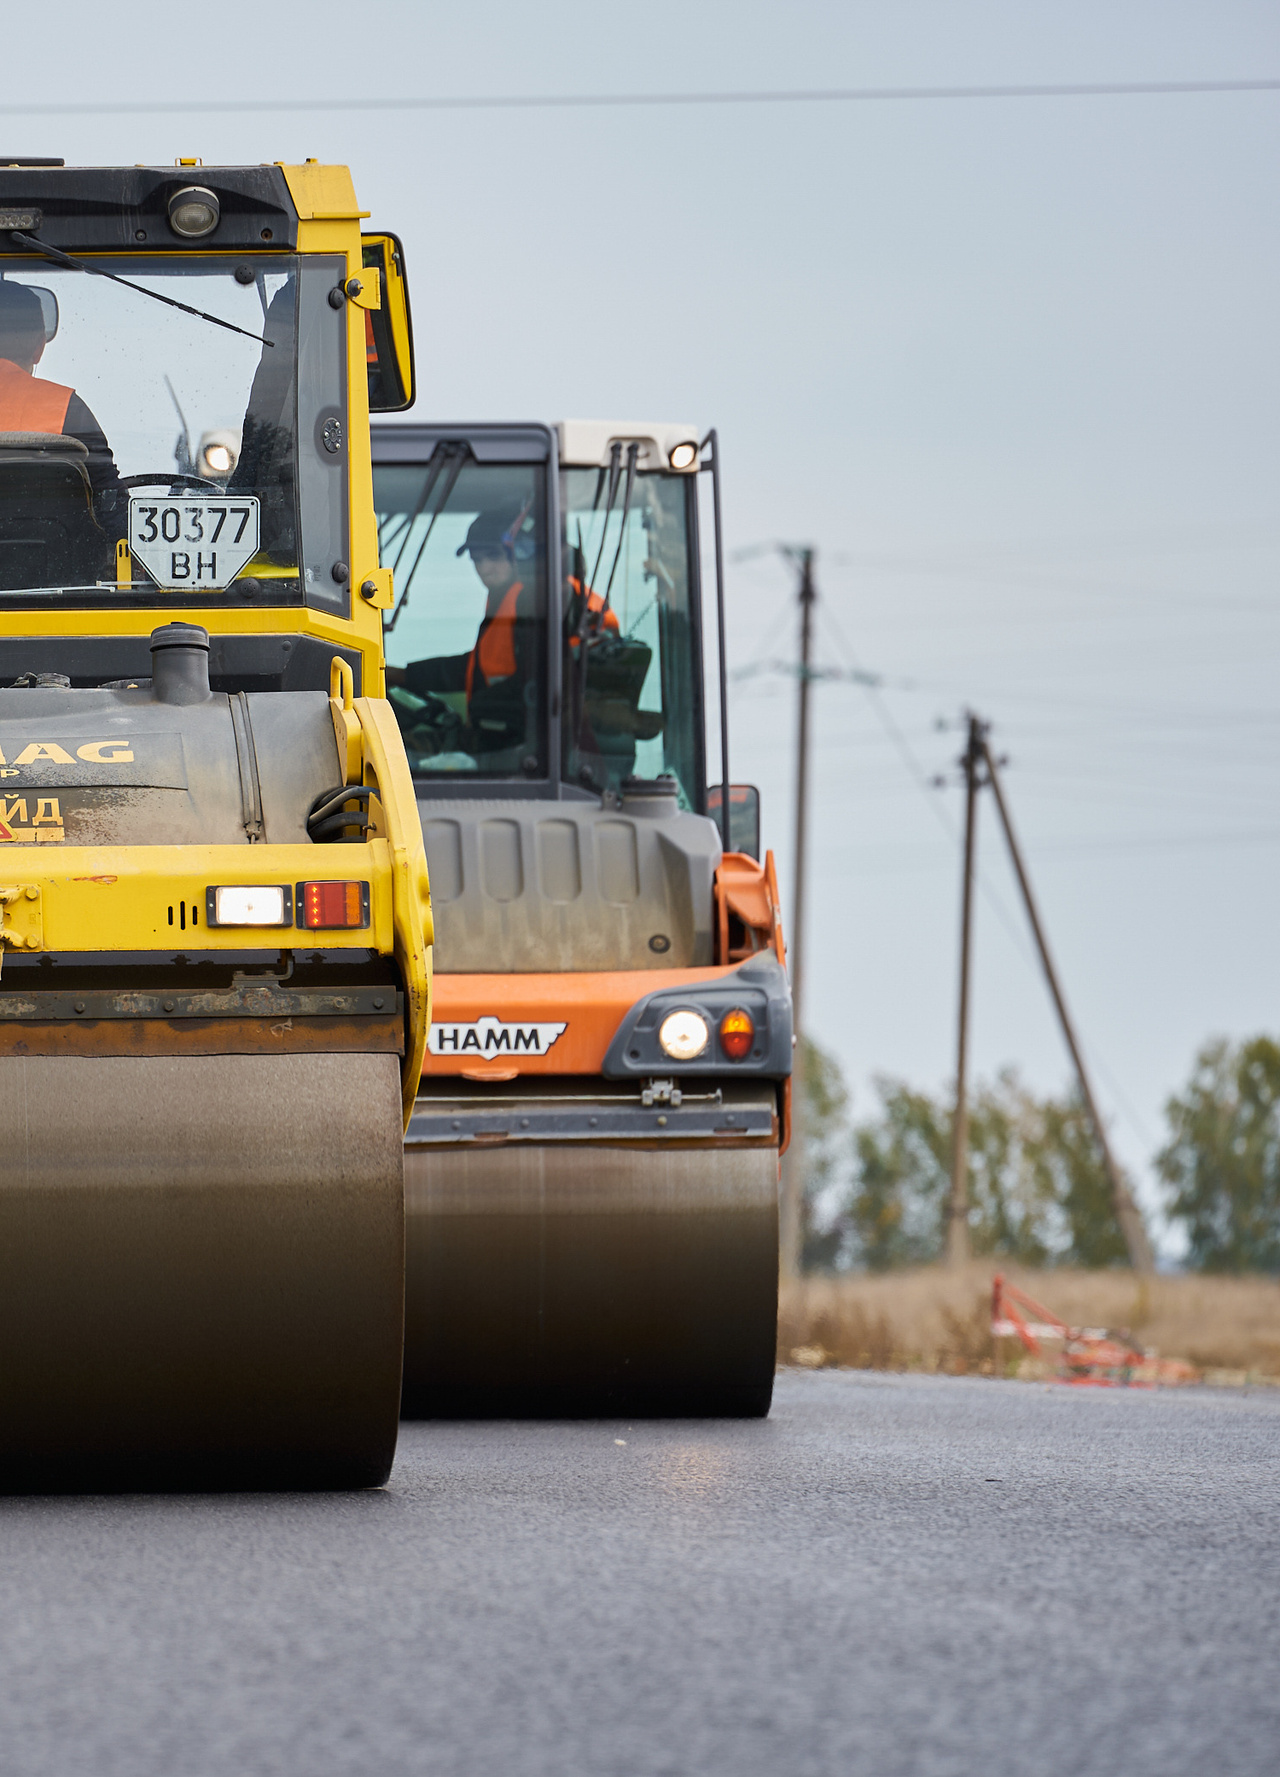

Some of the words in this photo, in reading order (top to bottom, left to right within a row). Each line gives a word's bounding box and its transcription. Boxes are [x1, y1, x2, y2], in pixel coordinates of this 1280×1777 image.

[138, 507, 250, 543] 30377
[171, 552, 217, 579] BH
[438, 1028, 540, 1050] HAMM
